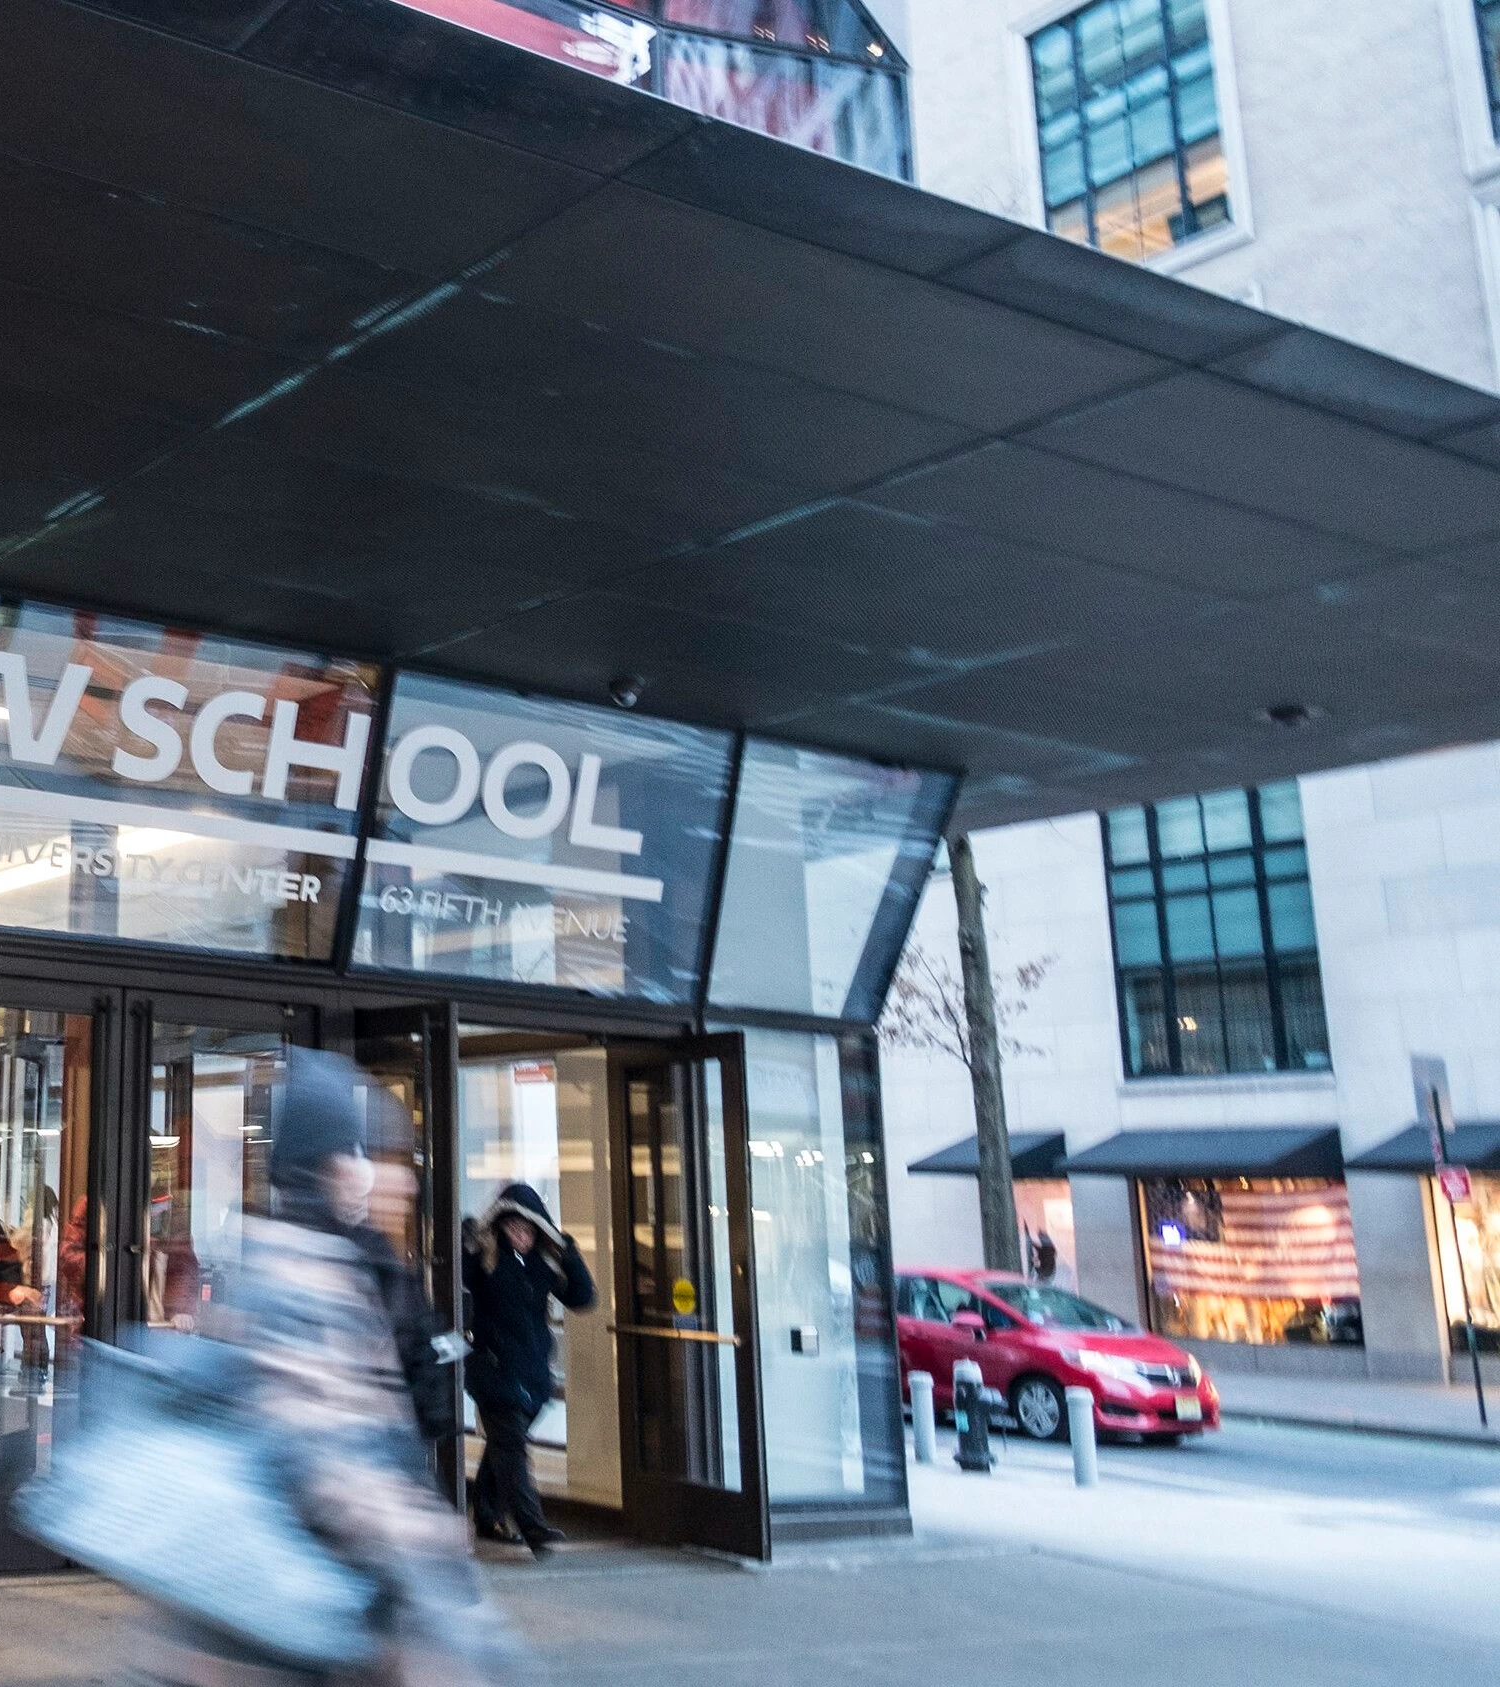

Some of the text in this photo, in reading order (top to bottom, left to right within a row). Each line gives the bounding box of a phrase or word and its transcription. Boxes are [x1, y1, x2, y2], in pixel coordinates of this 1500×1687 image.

[112, 678, 642, 855] SCHOOL
[179, 859, 322, 904] CENTER
[379, 885, 631, 943] 63 FIFTH AVENUE
